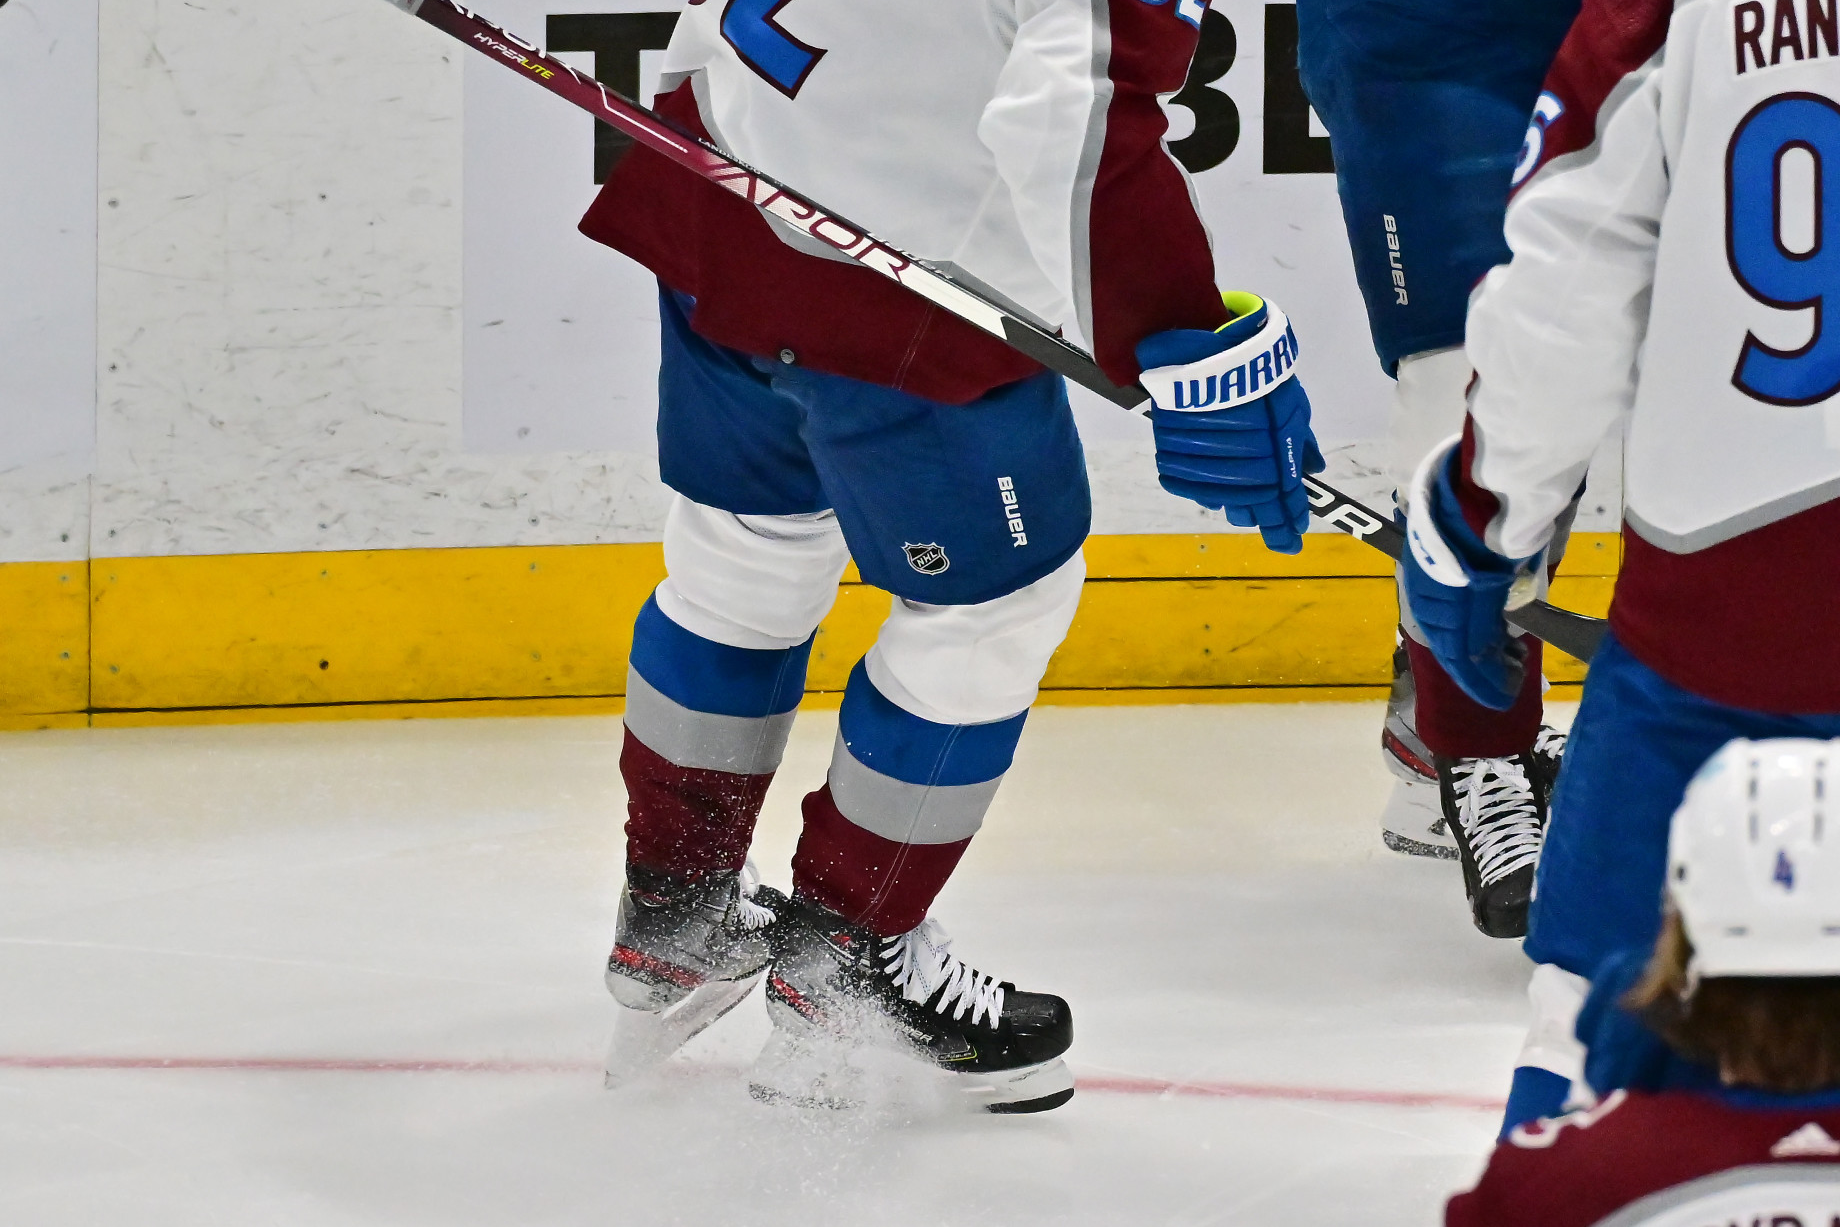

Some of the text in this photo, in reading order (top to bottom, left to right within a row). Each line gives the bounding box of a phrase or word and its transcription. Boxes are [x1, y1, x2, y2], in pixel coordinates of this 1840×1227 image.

[474, 31, 555, 80] HYPERLITE
[1385, 214, 1409, 306] BAUER
[997, 476, 1028, 548] BAUER
[916, 546, 940, 566] NHL
